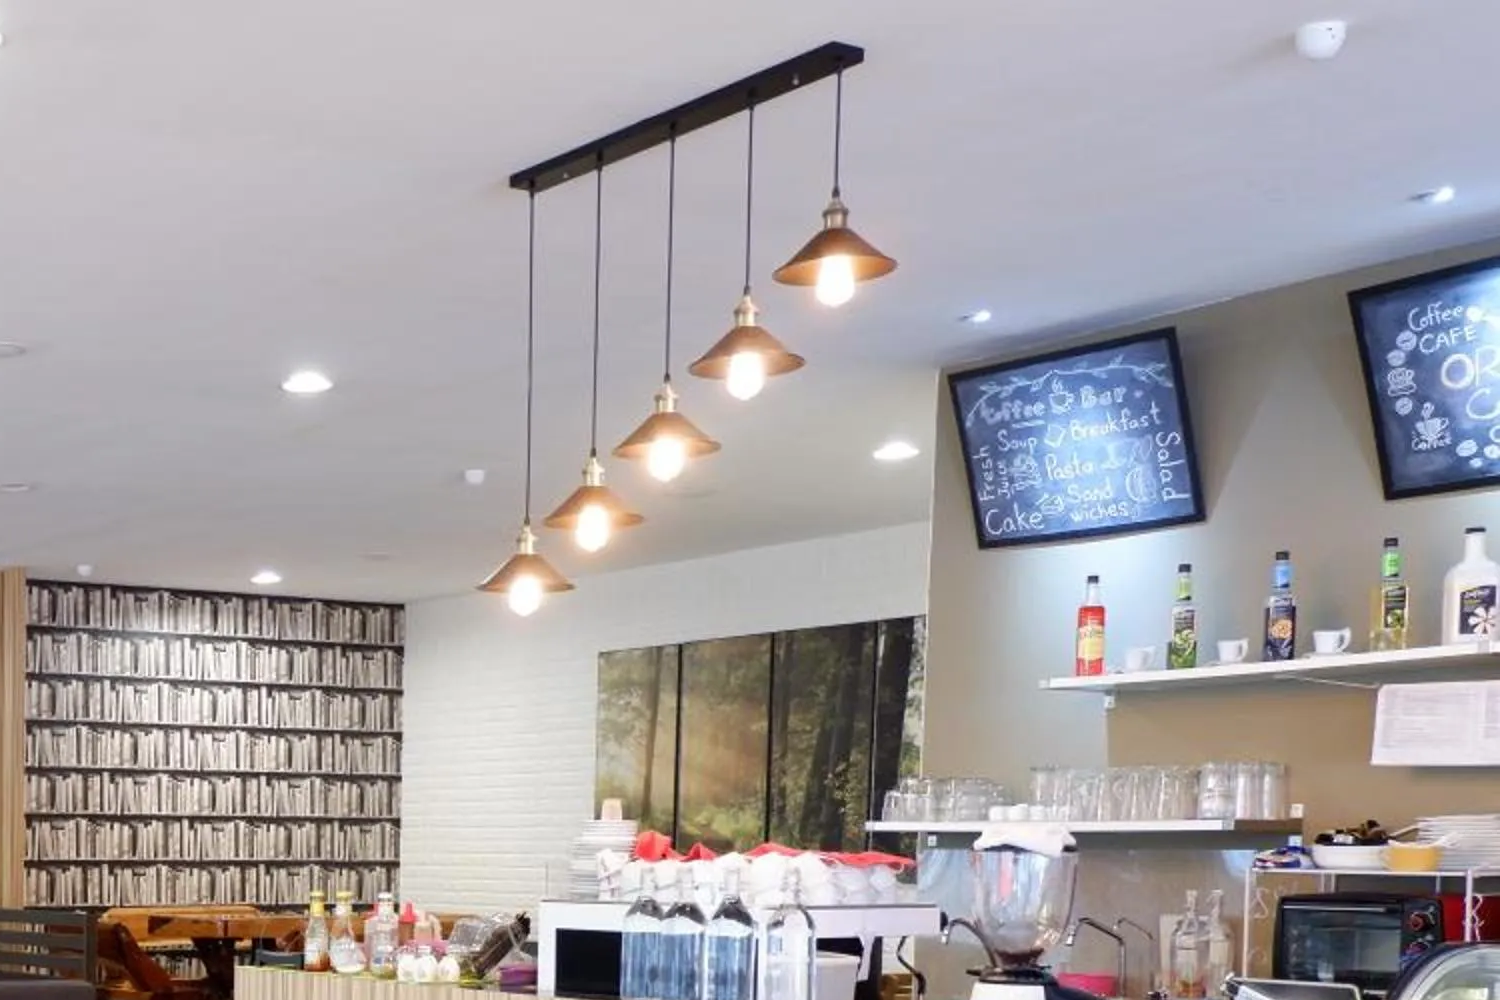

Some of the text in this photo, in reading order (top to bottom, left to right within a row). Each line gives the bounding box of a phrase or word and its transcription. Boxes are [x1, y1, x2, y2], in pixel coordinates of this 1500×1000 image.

[1408, 301, 1465, 331] Coffee
[1418, 326, 1478, 355] CAFE
[1071, 400, 1162, 441] Breakfast
[997, 429, 1037, 455] Soup
[972, 445, 996, 502] Fresh
[1045, 452, 1094, 481] Pasta
[1156, 432, 1192, 502] Salad
[985, 501, 1045, 536] Cake
